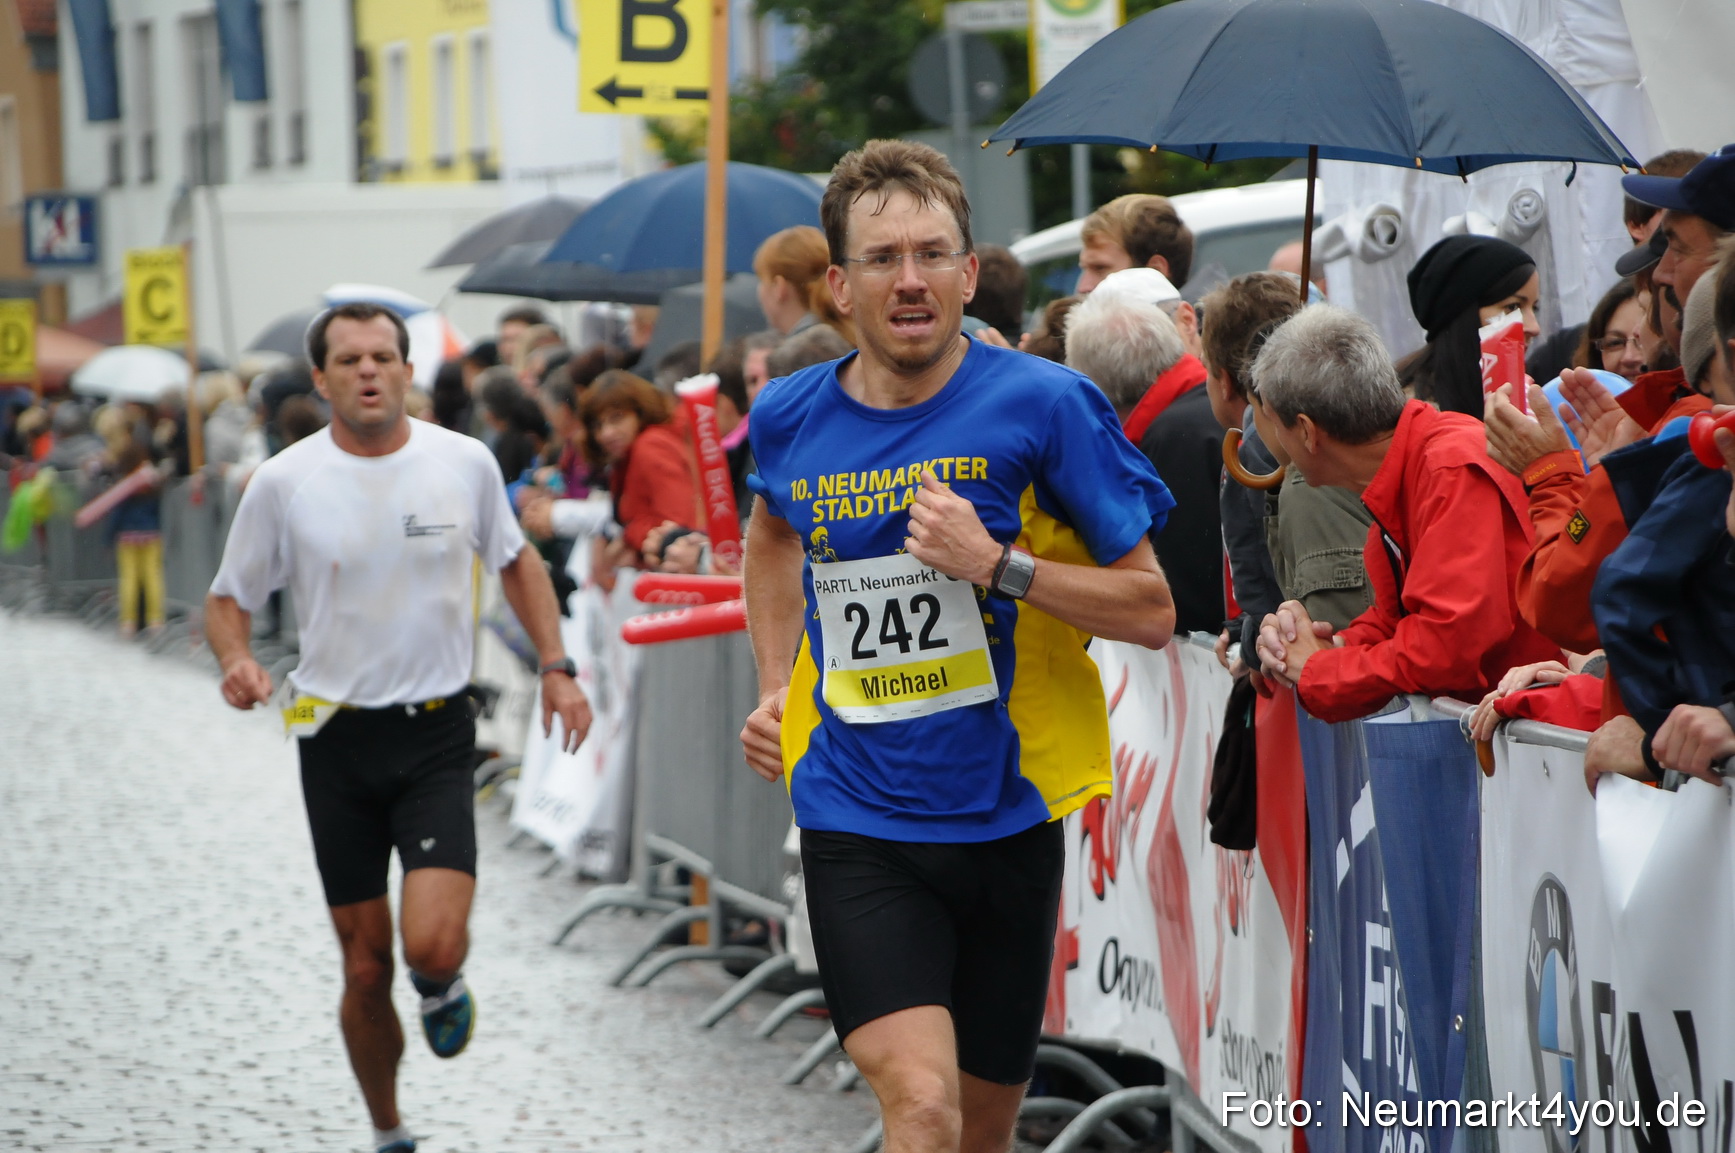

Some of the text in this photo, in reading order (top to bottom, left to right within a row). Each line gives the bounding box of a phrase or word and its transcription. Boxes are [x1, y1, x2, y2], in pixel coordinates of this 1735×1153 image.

[620, 0, 690, 63] B
[139, 275, 175, 326] C
[790, 456, 988, 502] 10. NEUMARKTER
[812, 483, 950, 523] STADTLA
[815, 568, 939, 595] PARTL Neumarkt
[844, 592, 949, 660] 242
[860, 666, 949, 700] Michael
